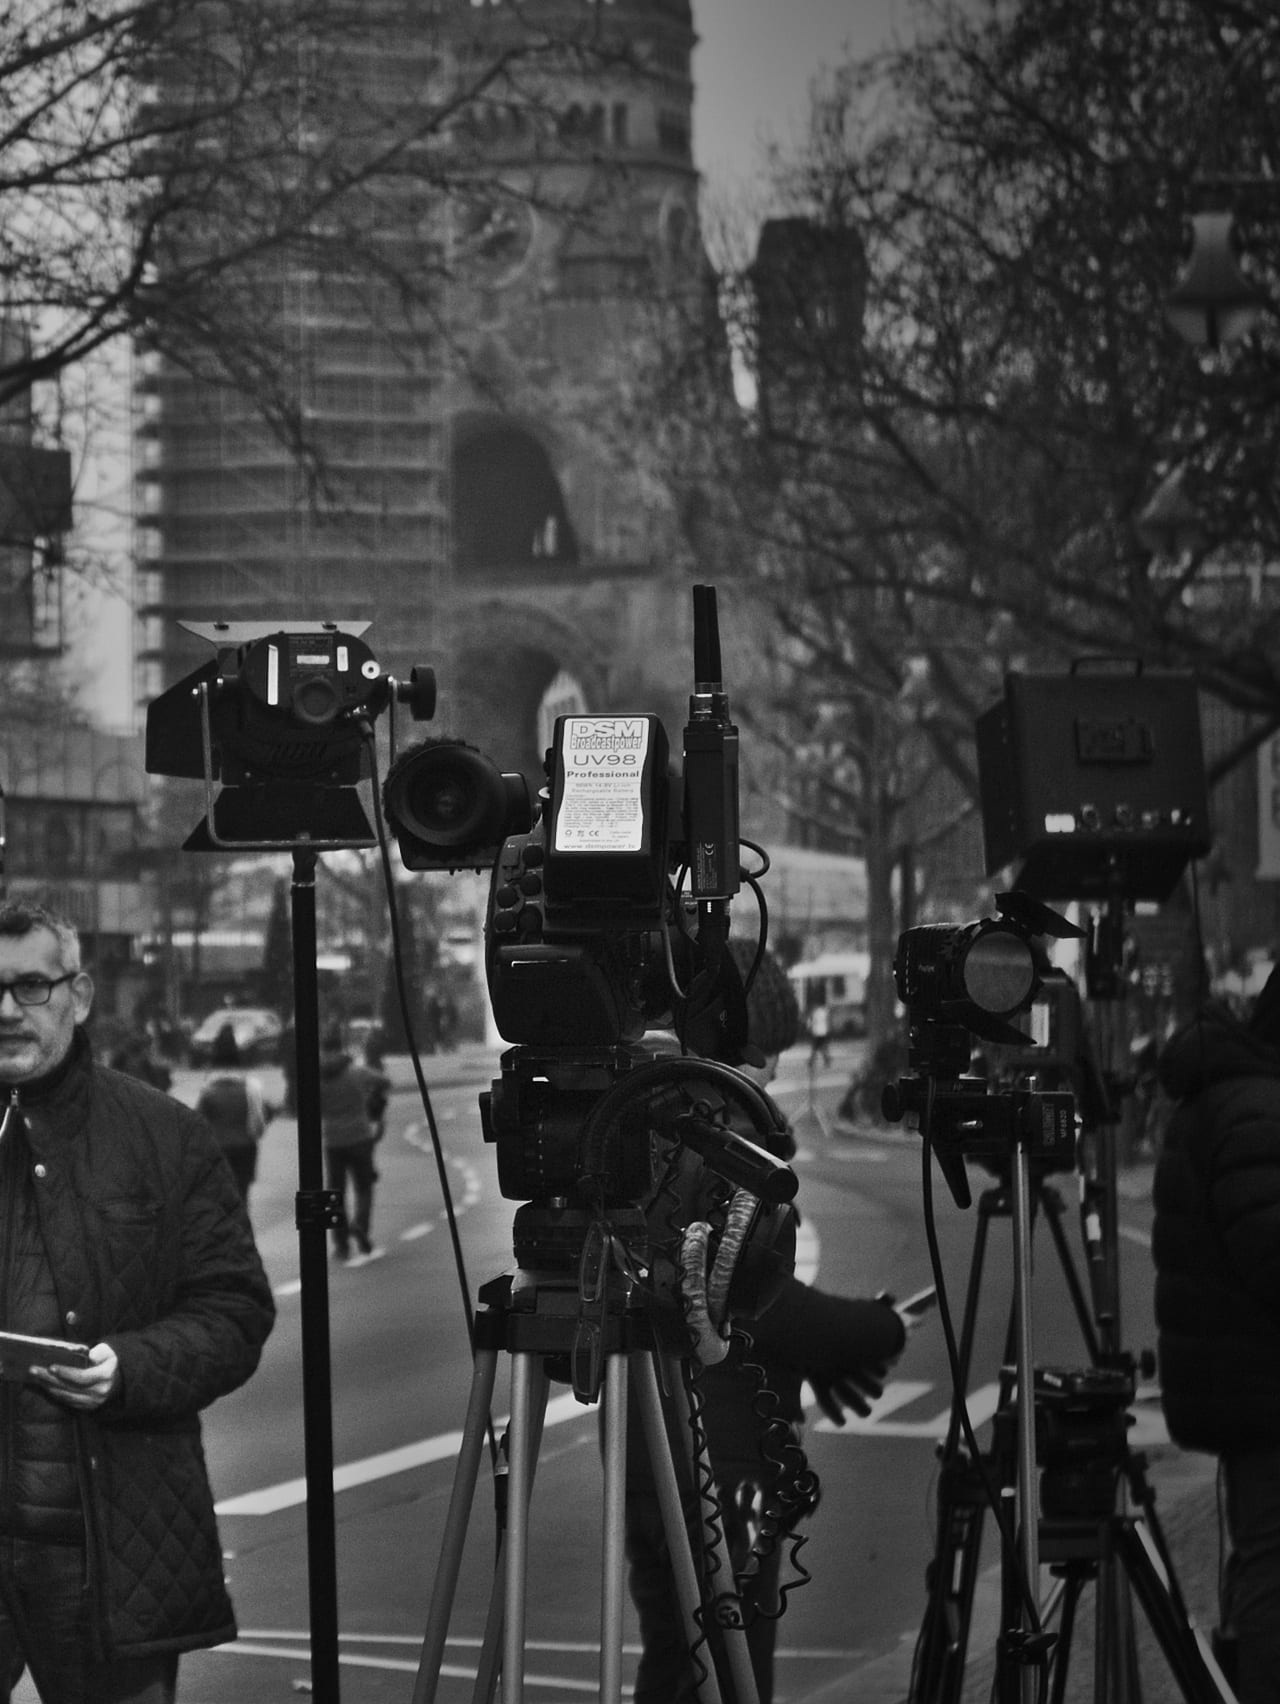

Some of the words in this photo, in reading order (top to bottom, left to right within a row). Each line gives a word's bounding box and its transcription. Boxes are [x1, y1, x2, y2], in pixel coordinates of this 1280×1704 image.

[571, 720, 643, 738] DSM
[570, 734, 642, 752] Broadcastpower
[573, 754, 637, 766] UV98
[566, 770, 640, 778] Professional
